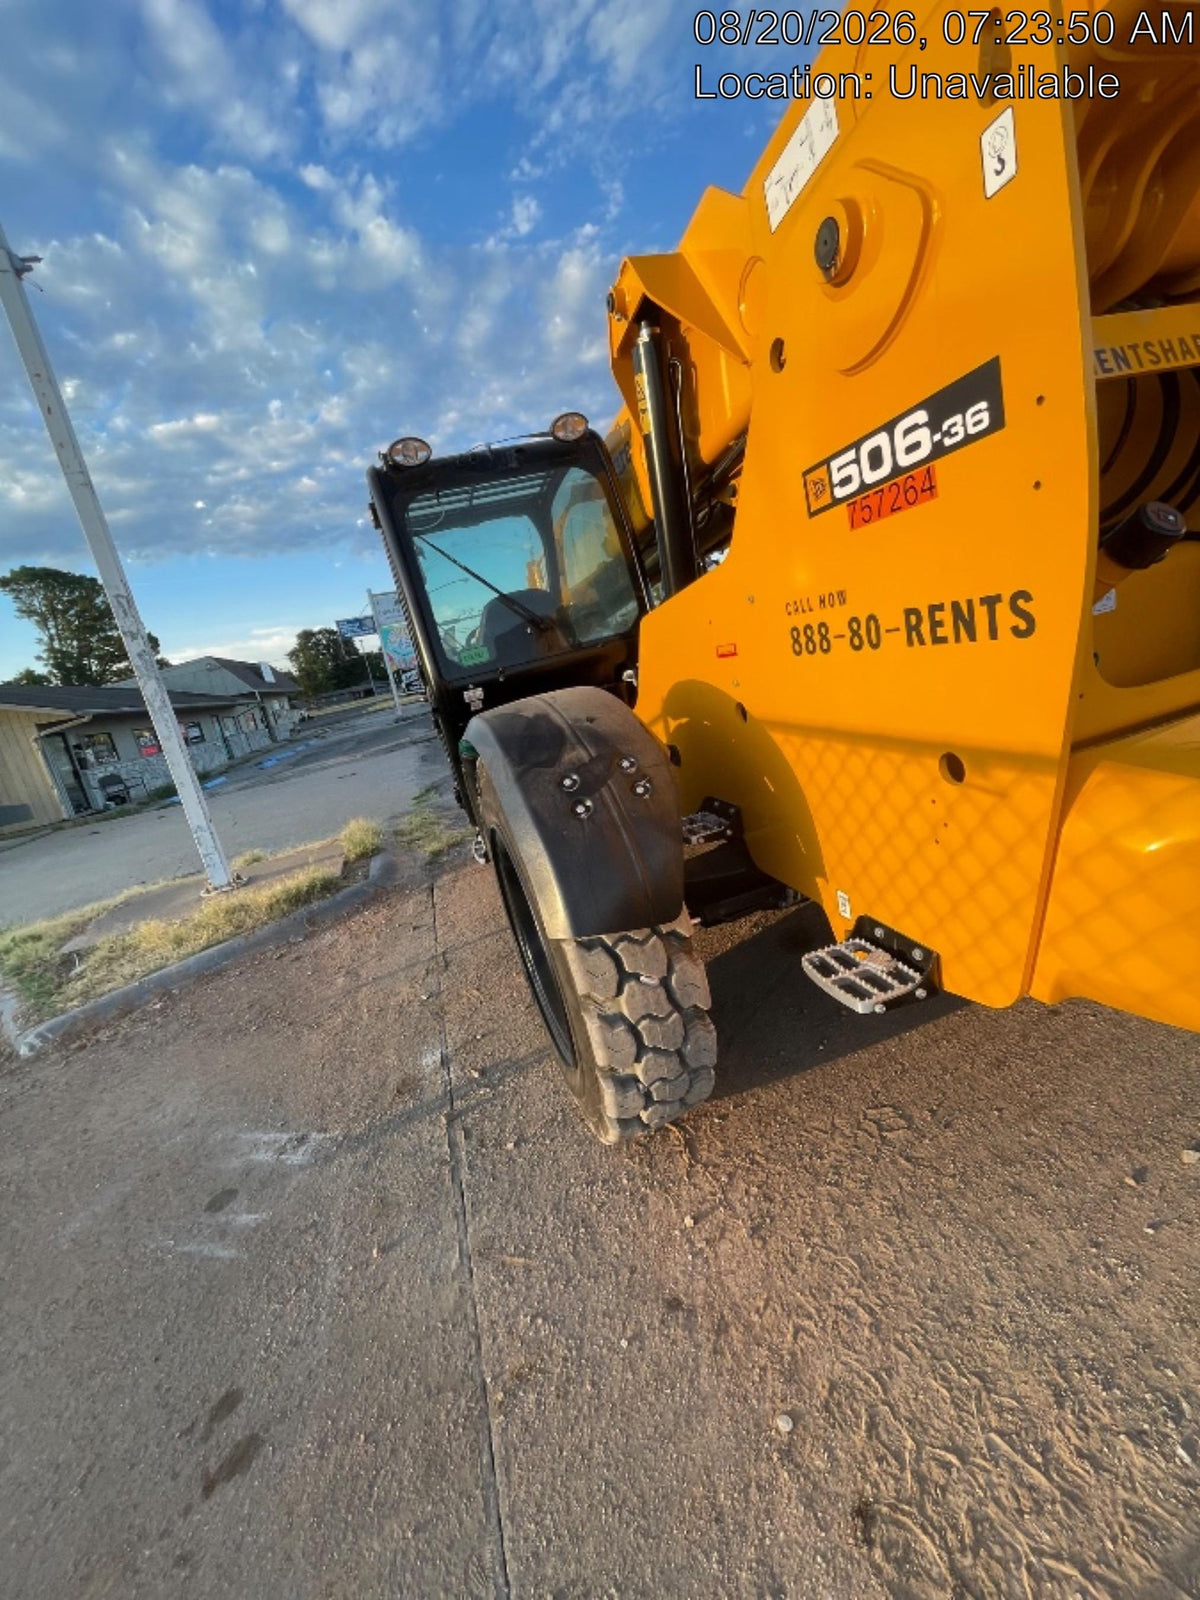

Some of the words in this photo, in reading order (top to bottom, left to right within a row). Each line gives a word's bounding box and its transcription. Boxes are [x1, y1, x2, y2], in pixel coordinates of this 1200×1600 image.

[830, 400, 990, 499] 506-36
[846, 465, 936, 529] 757264
[785, 597, 814, 617] CALL
[790, 590, 1036, 657] 888-80-RENTS
